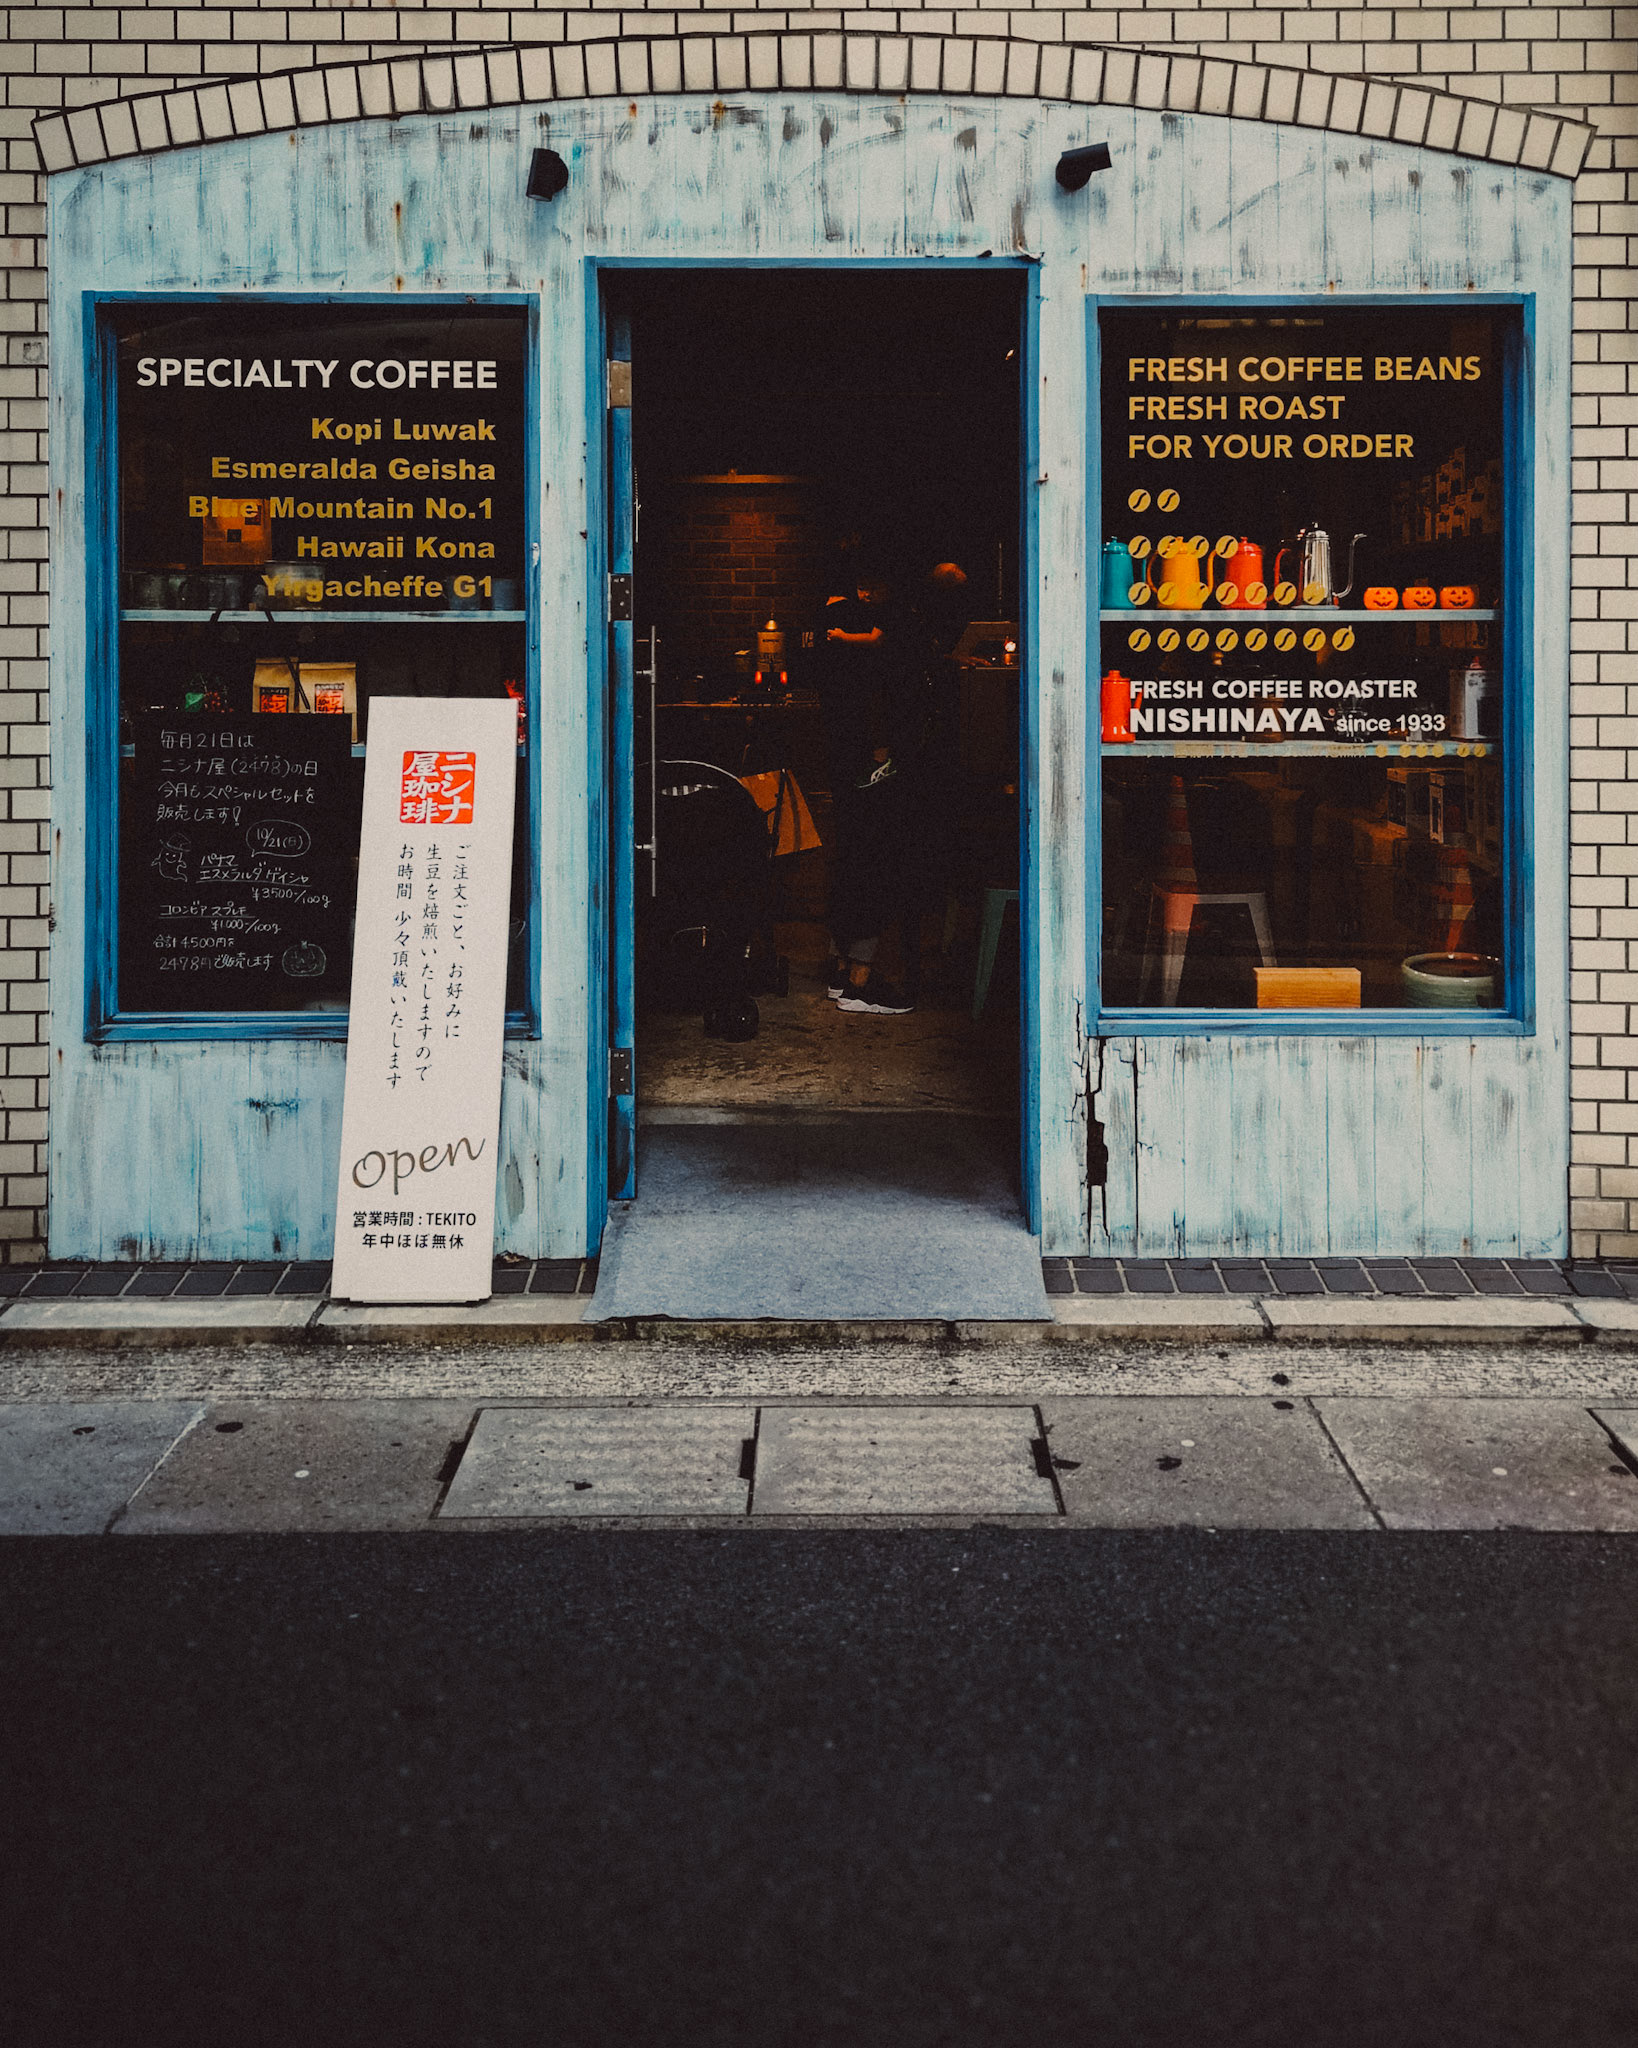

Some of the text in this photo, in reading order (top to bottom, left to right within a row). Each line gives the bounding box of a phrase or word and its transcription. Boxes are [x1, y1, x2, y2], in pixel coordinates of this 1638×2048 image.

[136, 357, 498, 389] SPECIALTY COFFEE
[1128, 355, 1482, 382] FRESH COFFEE BEANS
[1128, 395, 1346, 421] FRESH ROAST
[311, 417, 496, 445] Kopi Luwak
[1128, 434, 1414, 459] FOR YOUR ORDER
[211, 456, 495, 480] Esmeralda Geisha
[188, 495, 493, 520] Blue Mountain No.1
[297, 536, 495, 559] Hawaii Kona
[261, 575, 493, 602] Yirgacheffe G1
[1130, 679, 1417, 699] FRESH COFFEE ROASTER
[1129, 707, 1446, 733] NISHINAYA since 1933
[160, 729, 255, 749] 毎月21日は
[158, 780, 315, 803] 今月もスペシャルセットを
[400, 752, 440, 824] 屋珈琲
[437, 752, 475, 824] ニシナ
[200, 853, 236, 866] パナマ
[415, 843, 442, 1081] 生豆を焙煎いたしますので
[352, 1137, 486, 1195] Open
[362, 1233, 464, 1249] 年中ほぼ無休
